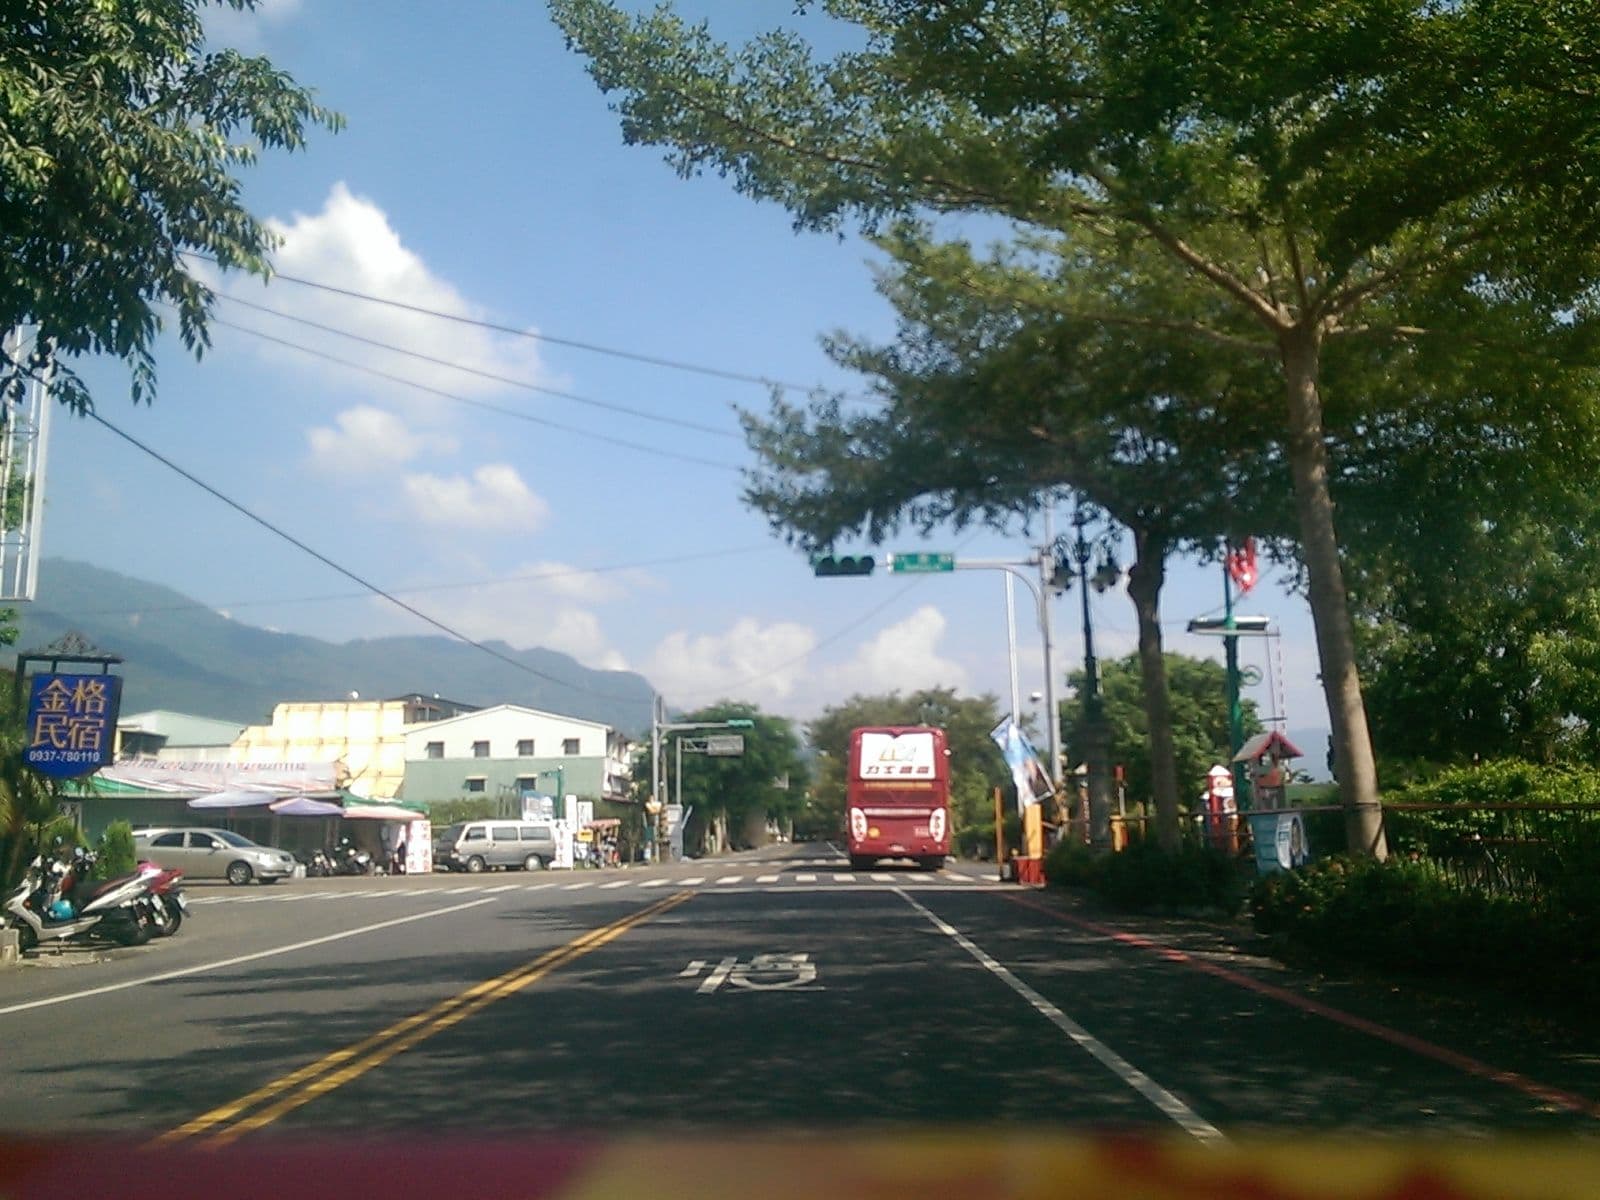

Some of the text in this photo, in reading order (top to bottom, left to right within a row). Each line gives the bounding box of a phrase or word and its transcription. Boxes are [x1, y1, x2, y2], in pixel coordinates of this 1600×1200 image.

[37, 678, 107, 714] 金格
[31, 714, 105, 750] 民宿
[29, 750, 100, 762] 0937-780110
[675, 952, 826, 994] 慢
